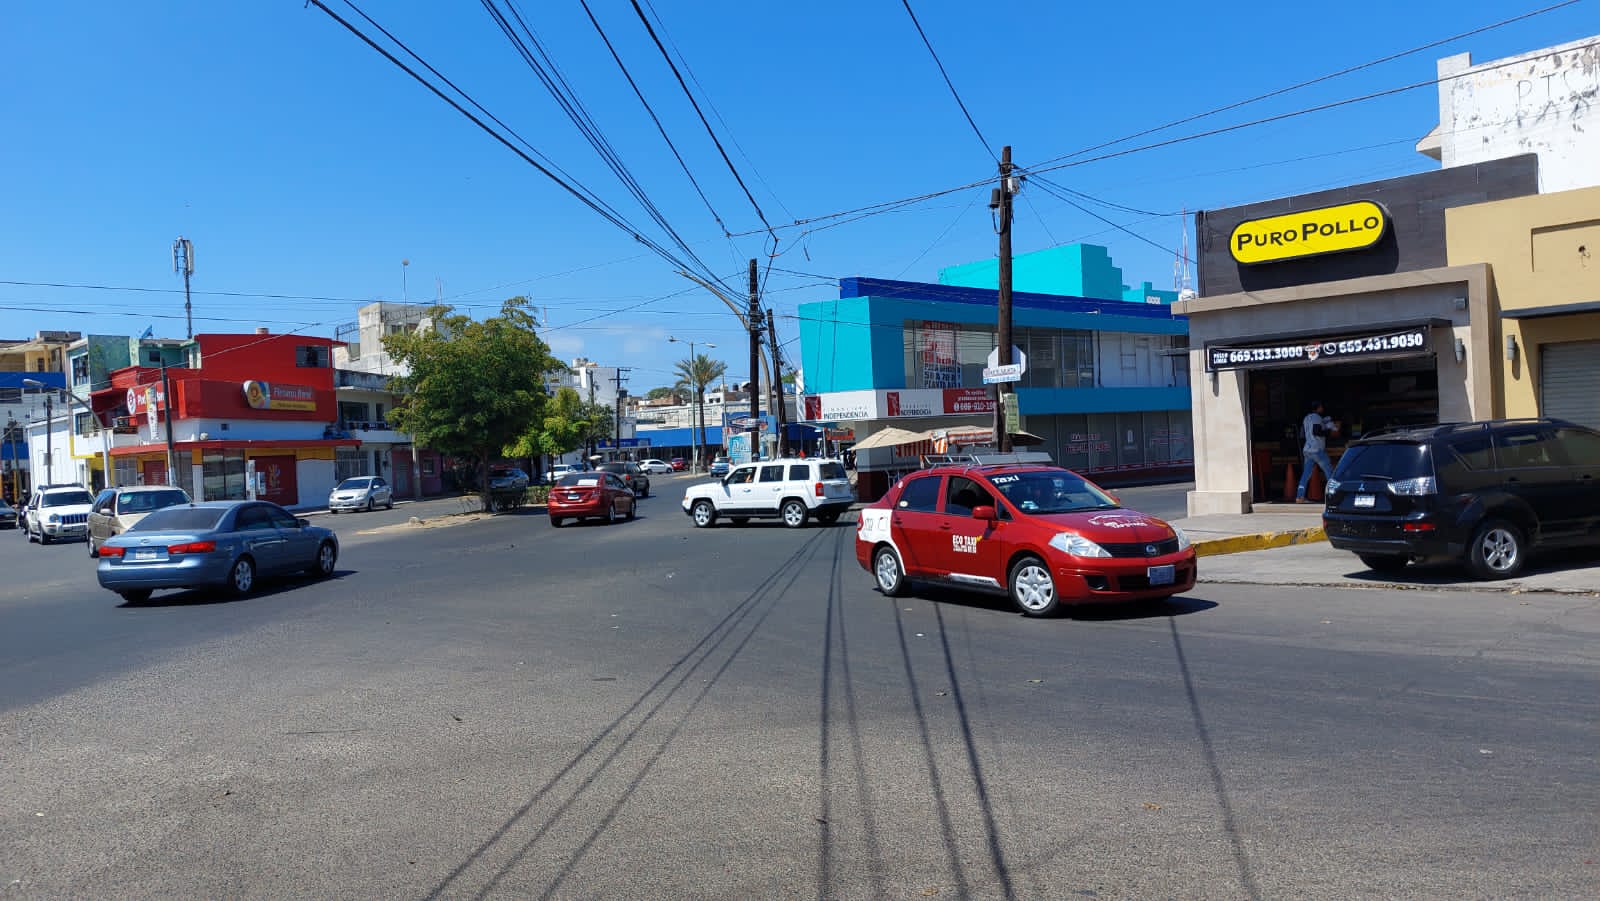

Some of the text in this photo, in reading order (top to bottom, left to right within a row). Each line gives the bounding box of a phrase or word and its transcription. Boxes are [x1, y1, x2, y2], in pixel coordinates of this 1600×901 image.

[1237, 216, 1380, 251] PURO POLLO
[1230, 346, 1303, 363] 669.133.3000
[823, 410, 869, 420] INDEPENDENCIA
[952, 534, 977, 546] ECO TAXI
